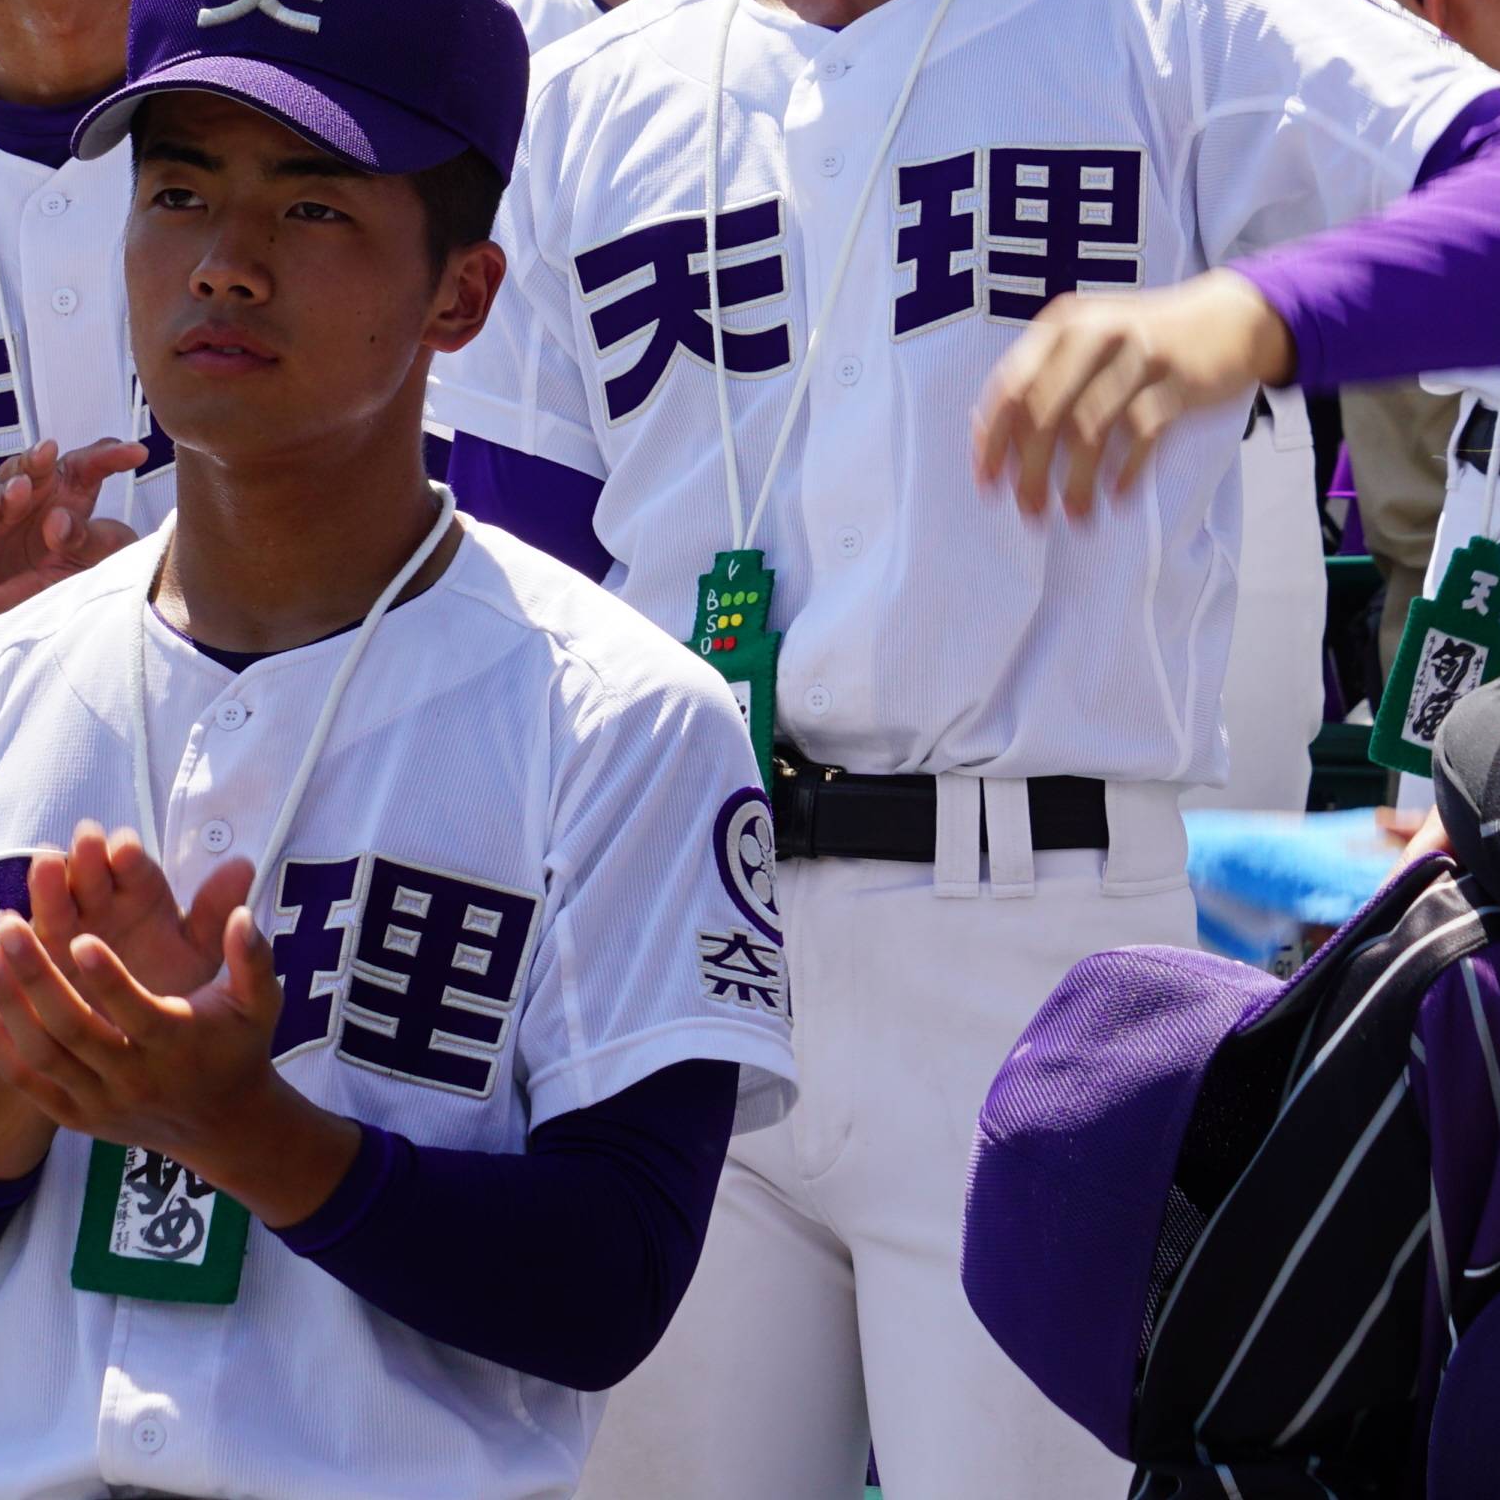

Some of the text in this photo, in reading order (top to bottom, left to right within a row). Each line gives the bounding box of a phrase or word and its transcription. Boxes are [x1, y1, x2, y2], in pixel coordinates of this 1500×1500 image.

[572, 143, 1150, 428] 天理
[706, 588, 719, 611] B
[1461, 570, 1500, 617] 天
[705, 613, 718, 634] S
[700, 637, 712, 656] O
